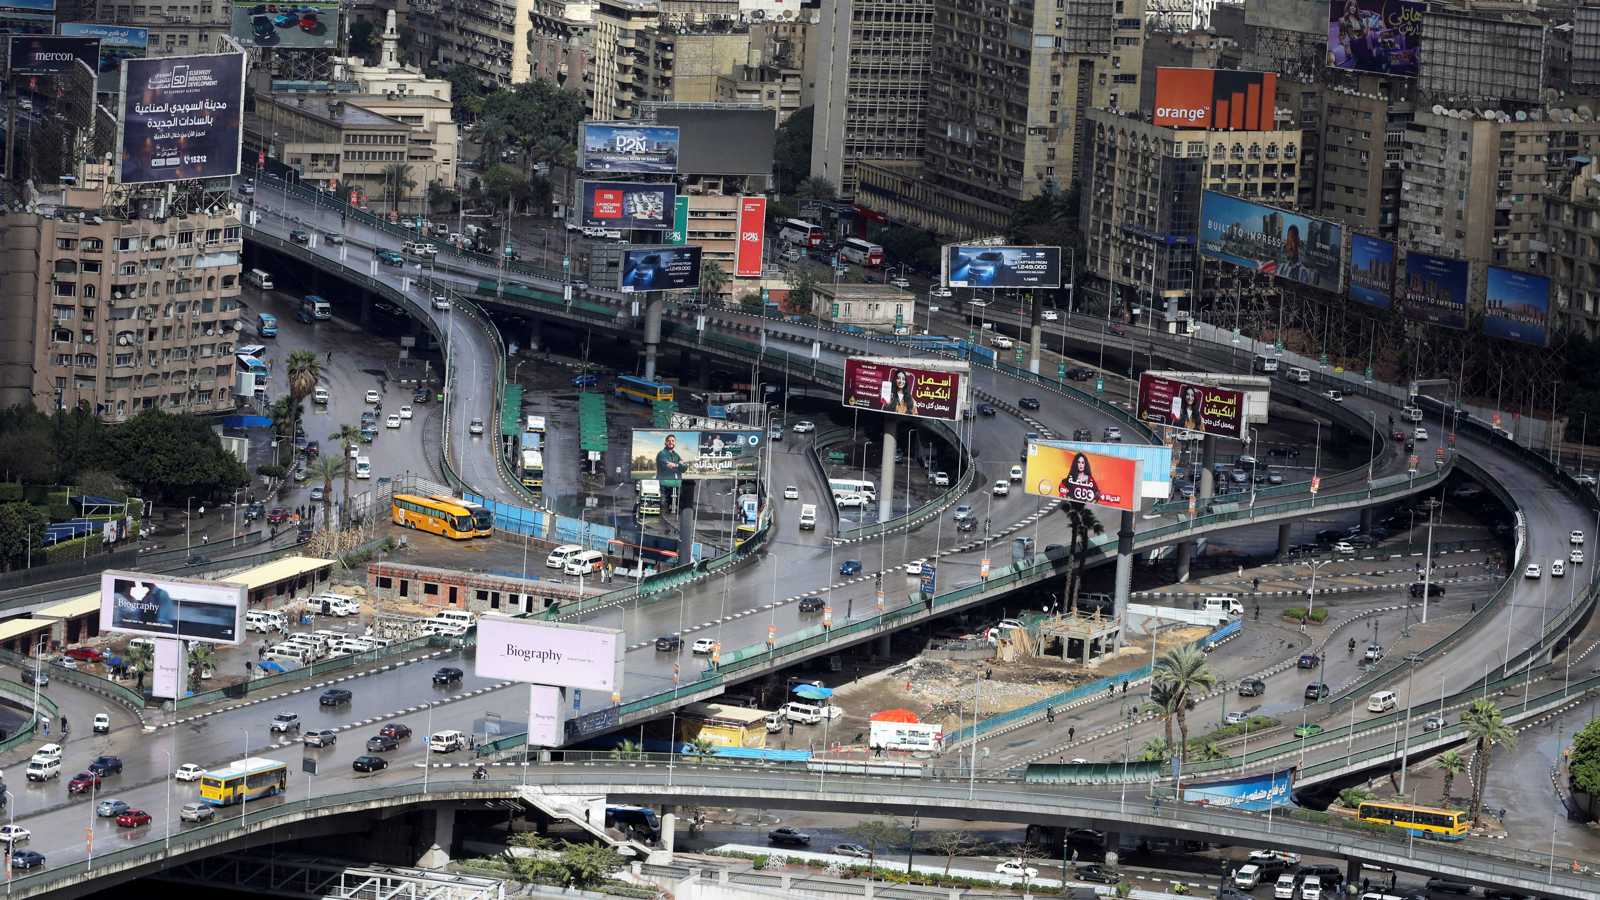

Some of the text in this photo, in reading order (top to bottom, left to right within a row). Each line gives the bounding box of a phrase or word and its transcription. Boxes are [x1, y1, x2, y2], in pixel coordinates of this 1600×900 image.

[35, 52, 74, 61] mercon
[174, 76, 185, 85] SD
[135, 99, 227, 117] مدينة السويدي الصناعية
[1156, 106, 1205, 121] orange
[147, 115, 213, 131] بالسادات الجديدة
[1207, 218, 1281, 248] BUILT TO IMPRESS
[1407, 292, 1464, 310] BUILT TO IMPRESS
[925, 401, 934, 410] كل
[118, 599, 160, 614] Biography
[506, 643, 563, 665] Biography
